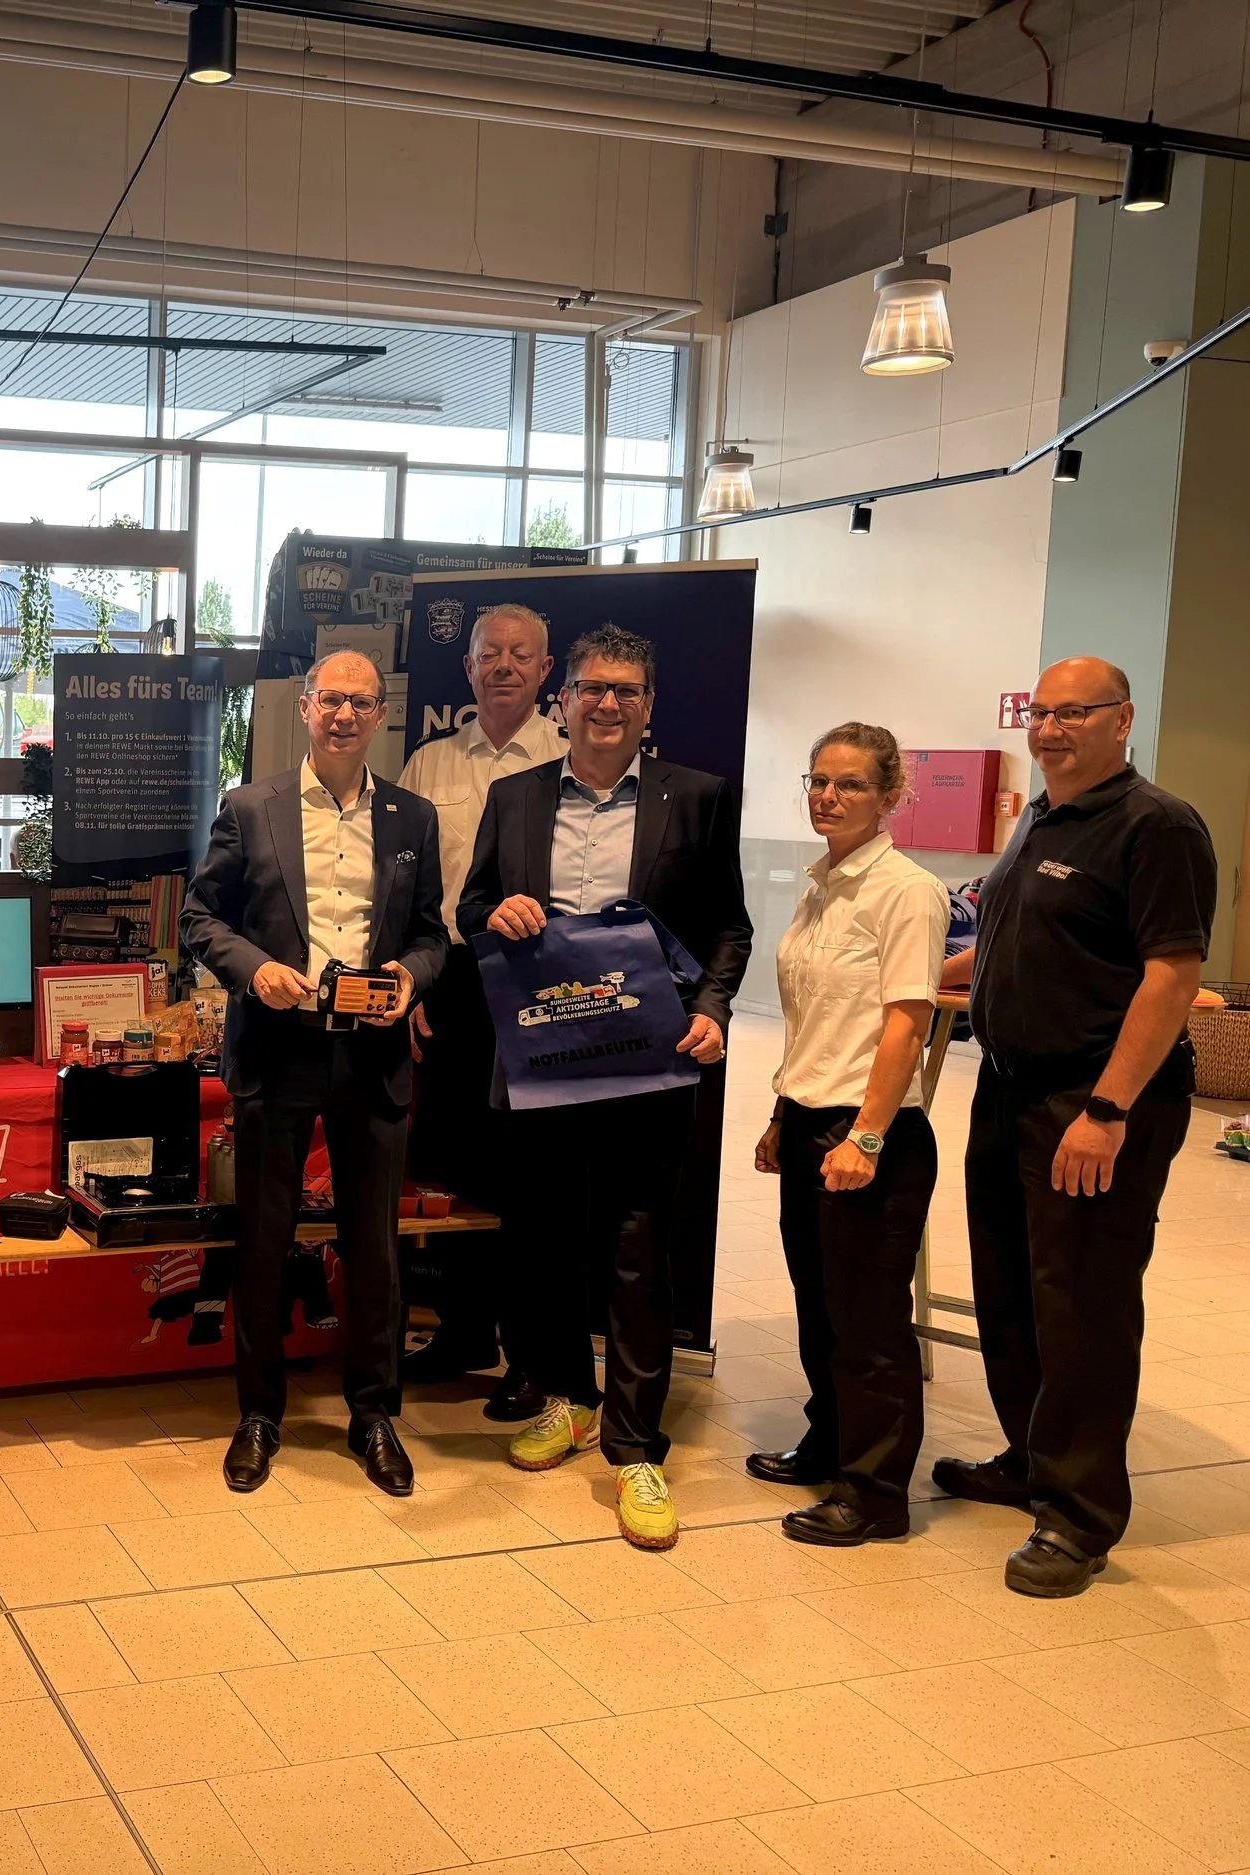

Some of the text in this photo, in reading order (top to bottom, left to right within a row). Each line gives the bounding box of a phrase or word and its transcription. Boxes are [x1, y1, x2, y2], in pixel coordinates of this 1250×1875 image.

[302, 546, 347, 559] Wieder da
[556, 554, 564, 562] für
[416, 553, 475, 569] Gemeinsam
[477, 557, 492, 569] für
[302, 592, 343, 604] SCHEINE
[303, 602, 340, 612] FÜR VEREINE
[65, 675, 218, 703] Alles fürs Team!
[65, 711, 135, 722] So einfach geht's
[65, 732, 72, 742] 1.
[76, 732, 87, 740] Bis
[89, 732, 110, 740] 11.10.
[111, 733, 124, 741] pro
[84, 742, 110, 750] deinem
[76, 752, 89, 760] den
[90, 752, 110, 760] REWE
[111, 753, 151, 762] Onlineshop
[64, 766, 73, 777] 2.
[75, 777, 95, 785] REWE
[95, 778, 110, 786] App
[97, 787, 138, 796] Sportverein
[64, 801, 72, 811] 3.
[75, 802, 92, 810] Nach
[93, 802, 123, 811] erfolgter
[124, 803, 170, 812] Registrierung
[75, 812, 119, 821] Sportvereine
[120, 812, 131, 820] die
[74, 821, 97, 829] 08.11.
[127, 823, 173, 831] Gratisprämien
[151, 966, 164, 978] ja!
[148, 988, 166, 997] KEKS
[550, 995, 591, 1006] BUNDESWEITE
[555, 998, 610, 1014] AKTIONSTAGE
[552, 1005, 621, 1021] BEVÖLKERUNGSSCHUTZ
[528, 1037, 654, 1069] NOTFALLBEUTEL
